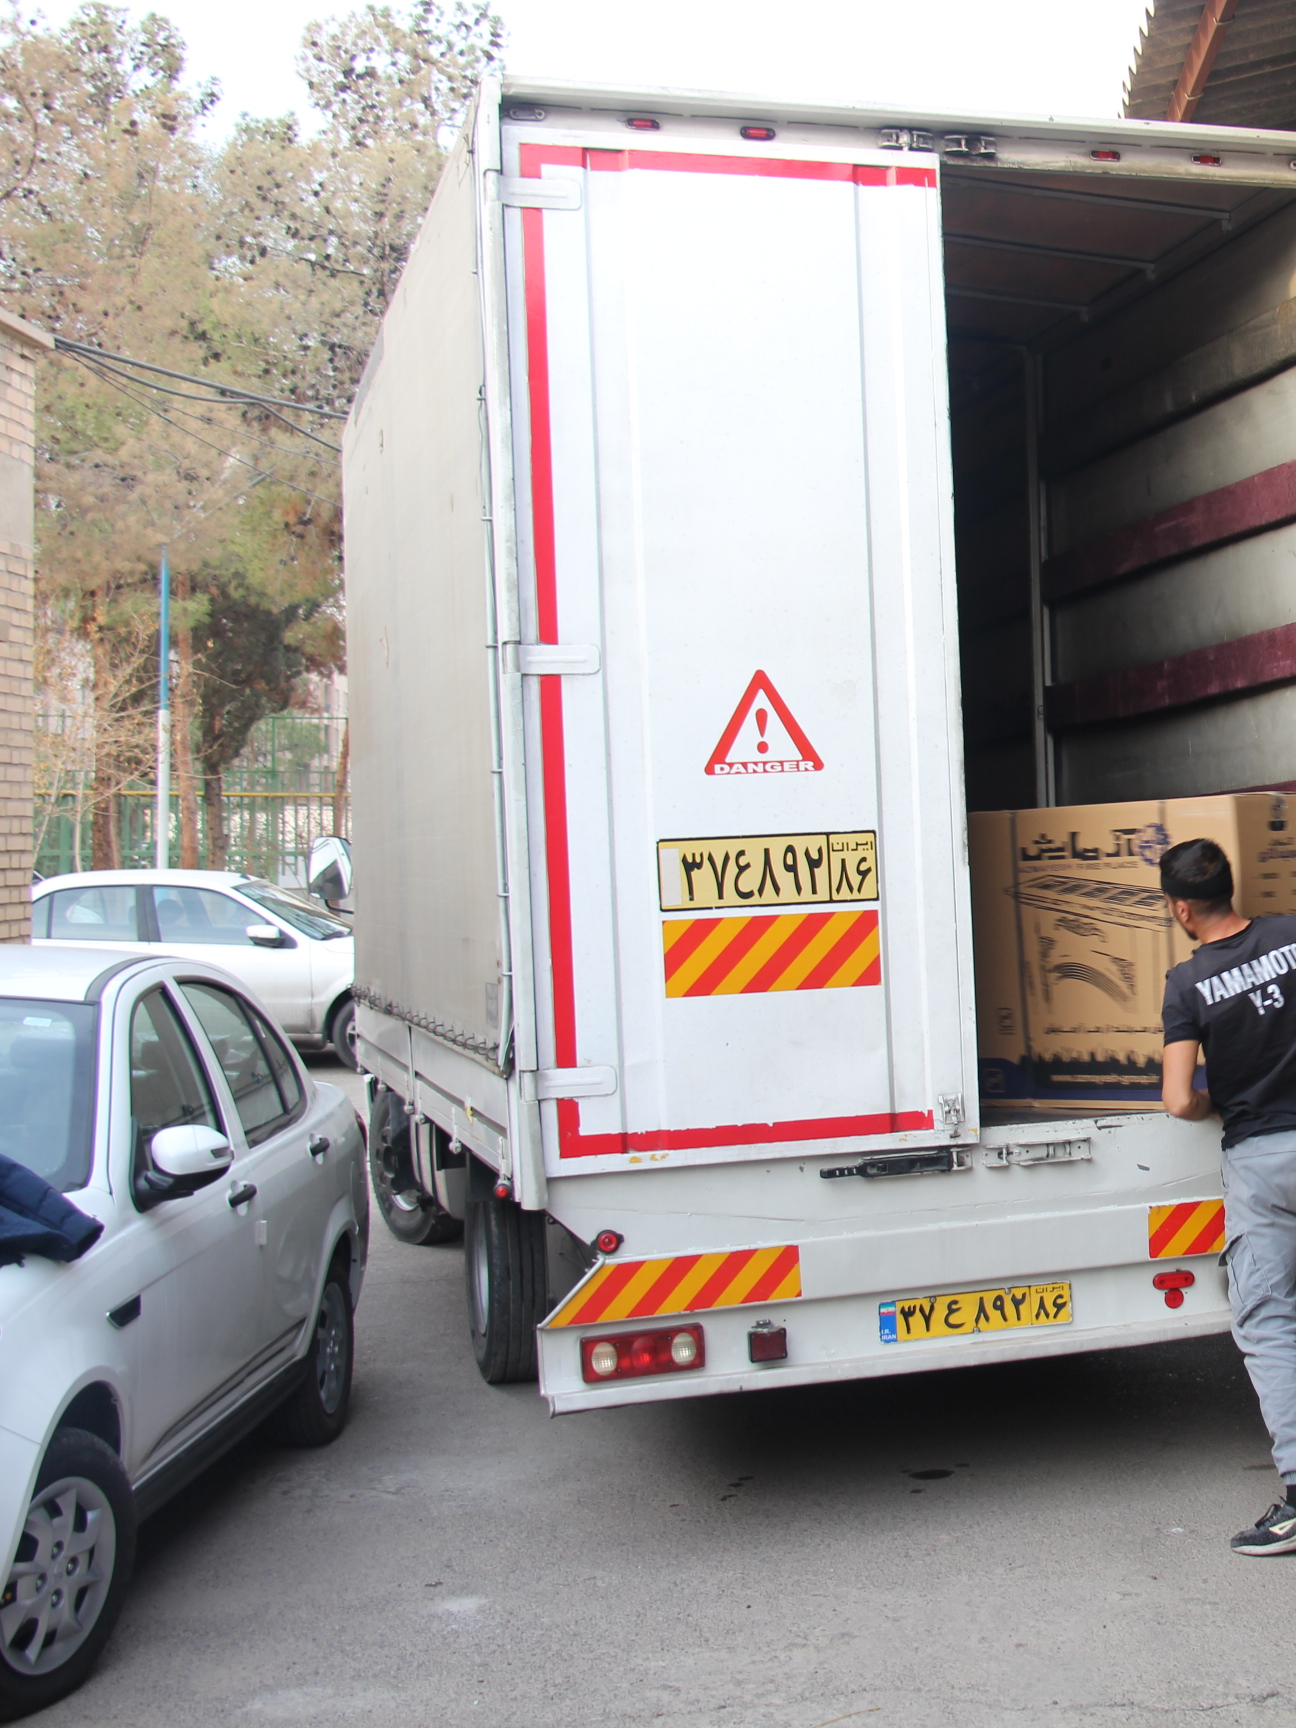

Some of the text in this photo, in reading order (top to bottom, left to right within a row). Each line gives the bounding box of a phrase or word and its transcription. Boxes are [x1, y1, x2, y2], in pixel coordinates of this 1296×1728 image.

[714, 761, 815, 774] DANGER
[831, 841, 873, 852] ایران
[1248, 984, 1285, 1016] Y-3
